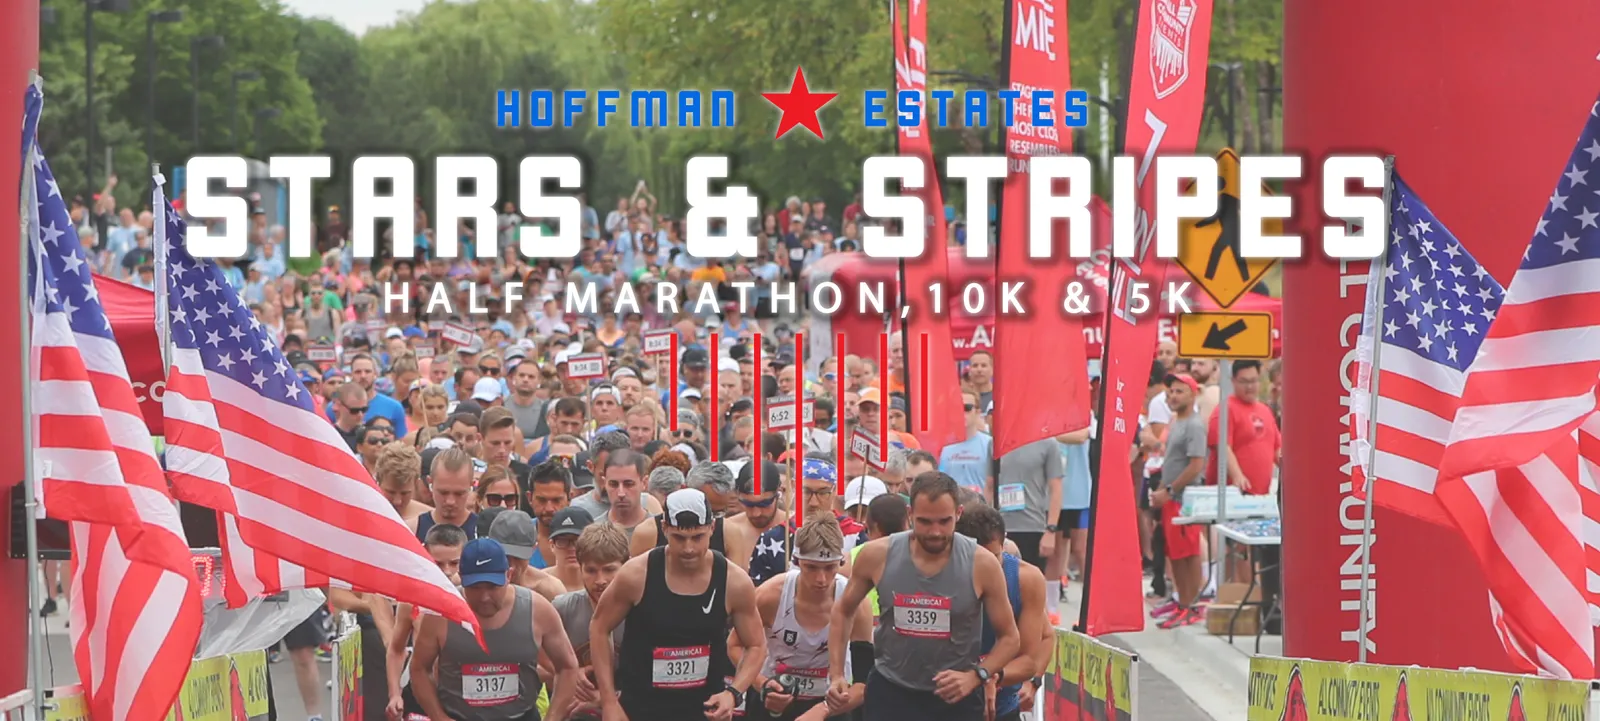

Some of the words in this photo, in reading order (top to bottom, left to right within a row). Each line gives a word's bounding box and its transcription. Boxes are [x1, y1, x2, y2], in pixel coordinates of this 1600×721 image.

[770, 410, 789, 423] 6:52
[907, 609, 938, 625] 3359
[666, 660, 696, 676] 3321
[476, 676, 506, 692] 3137
